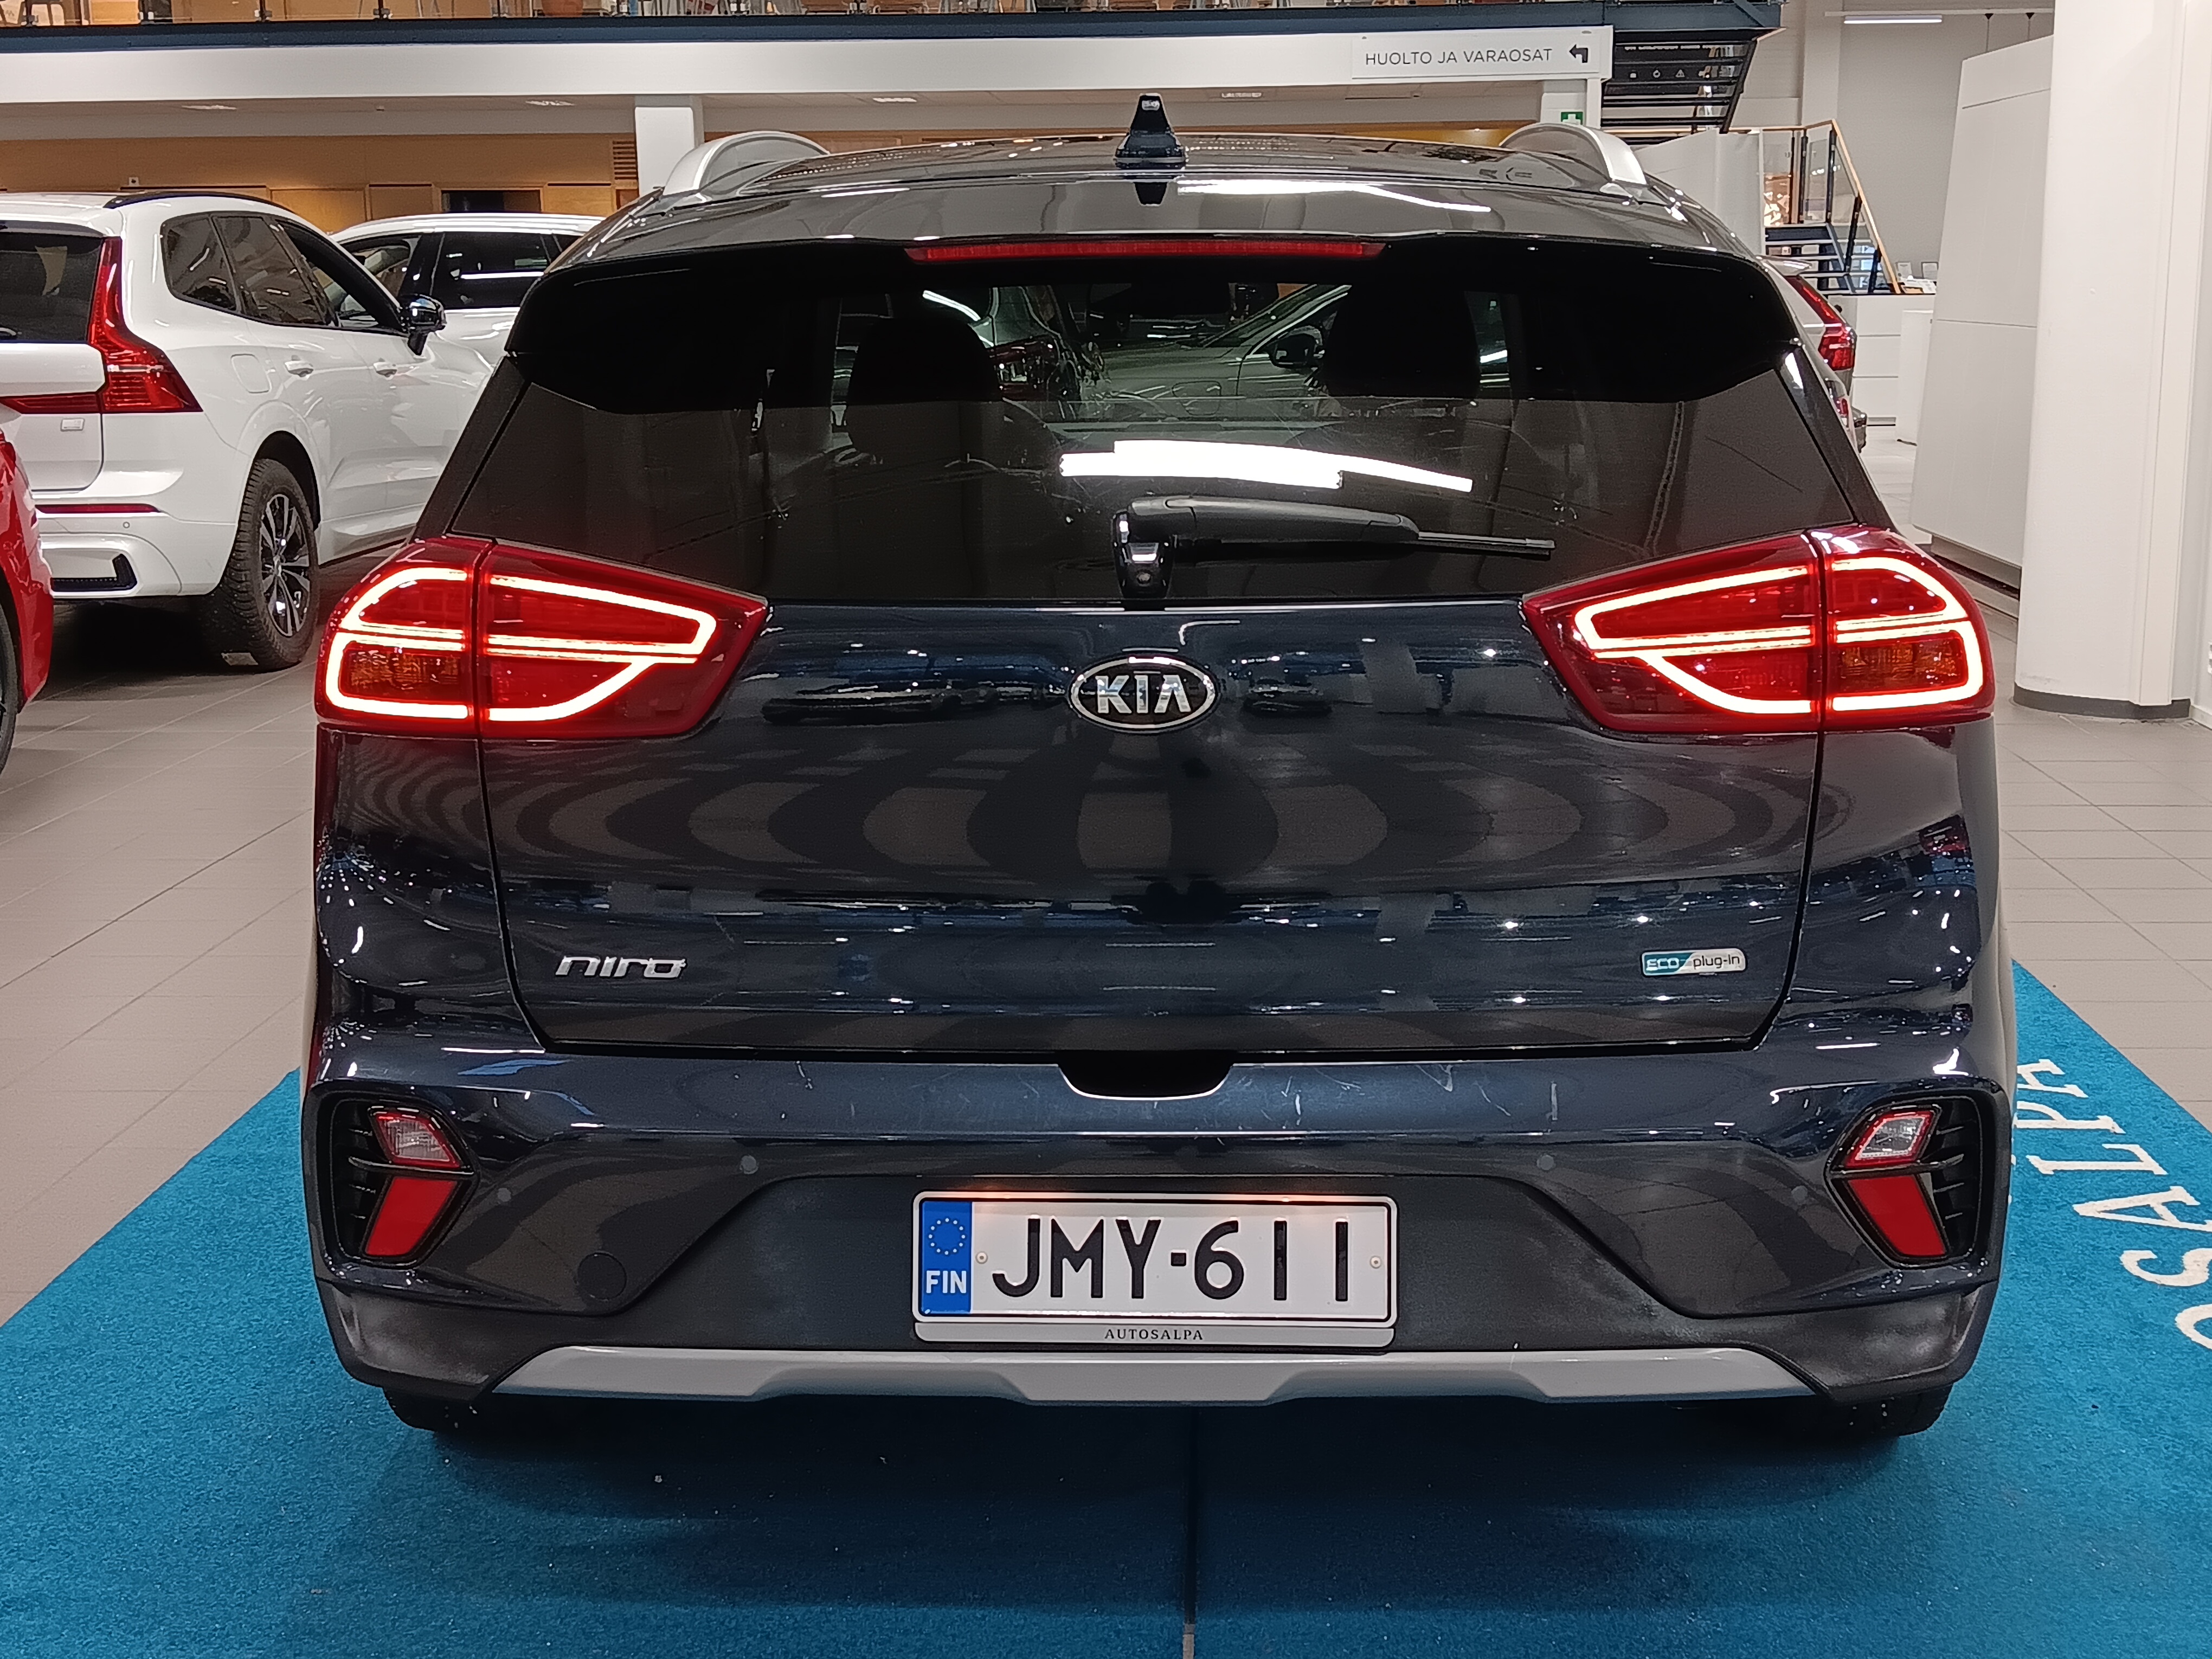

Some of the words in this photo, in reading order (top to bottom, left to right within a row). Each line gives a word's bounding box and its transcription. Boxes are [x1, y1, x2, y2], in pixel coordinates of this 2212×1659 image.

[1365, 52, 1432, 65] HUOLTO
[1437, 51, 1458, 64] JA
[1463, 48, 1553, 63] VARAOSAT
[1095, 675, 1191, 713] KIA
[1646, 957, 1679, 970] ECO
[992, 1218, 1348, 1302] JMY-611
[925, 1270, 967, 1294] FIN
[1104, 1328, 1204, 1340] AUTOSALPA
